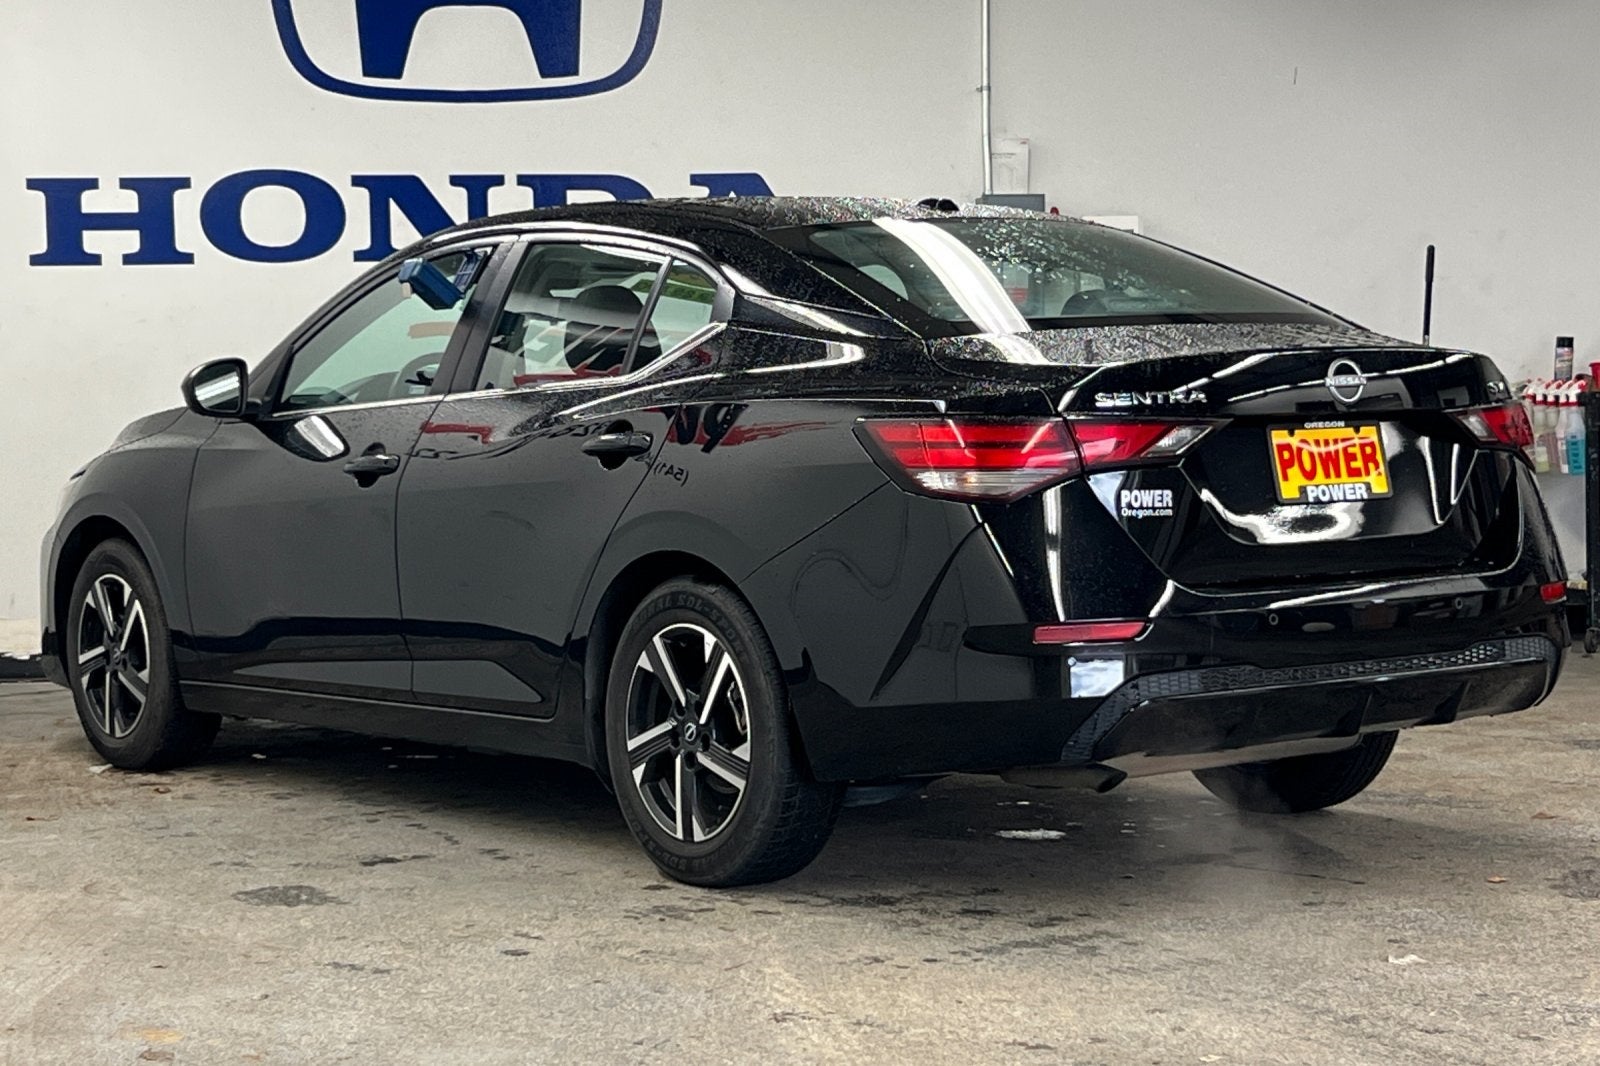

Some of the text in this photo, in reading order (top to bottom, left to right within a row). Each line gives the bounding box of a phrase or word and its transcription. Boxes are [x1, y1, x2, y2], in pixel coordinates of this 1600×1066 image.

[25, 168, 775, 265] HON
[1325, 374, 1367, 387] NISSAN
[1094, 391, 1208, 407] SENTRA
[1304, 420, 1345, 429] OREGON
[1275, 437, 1381, 482] POWER
[1121, 489, 1173, 508] POWER
[1306, 483, 1369, 502] POWER
[1121, 508, 1173, 519] Oregon.com
